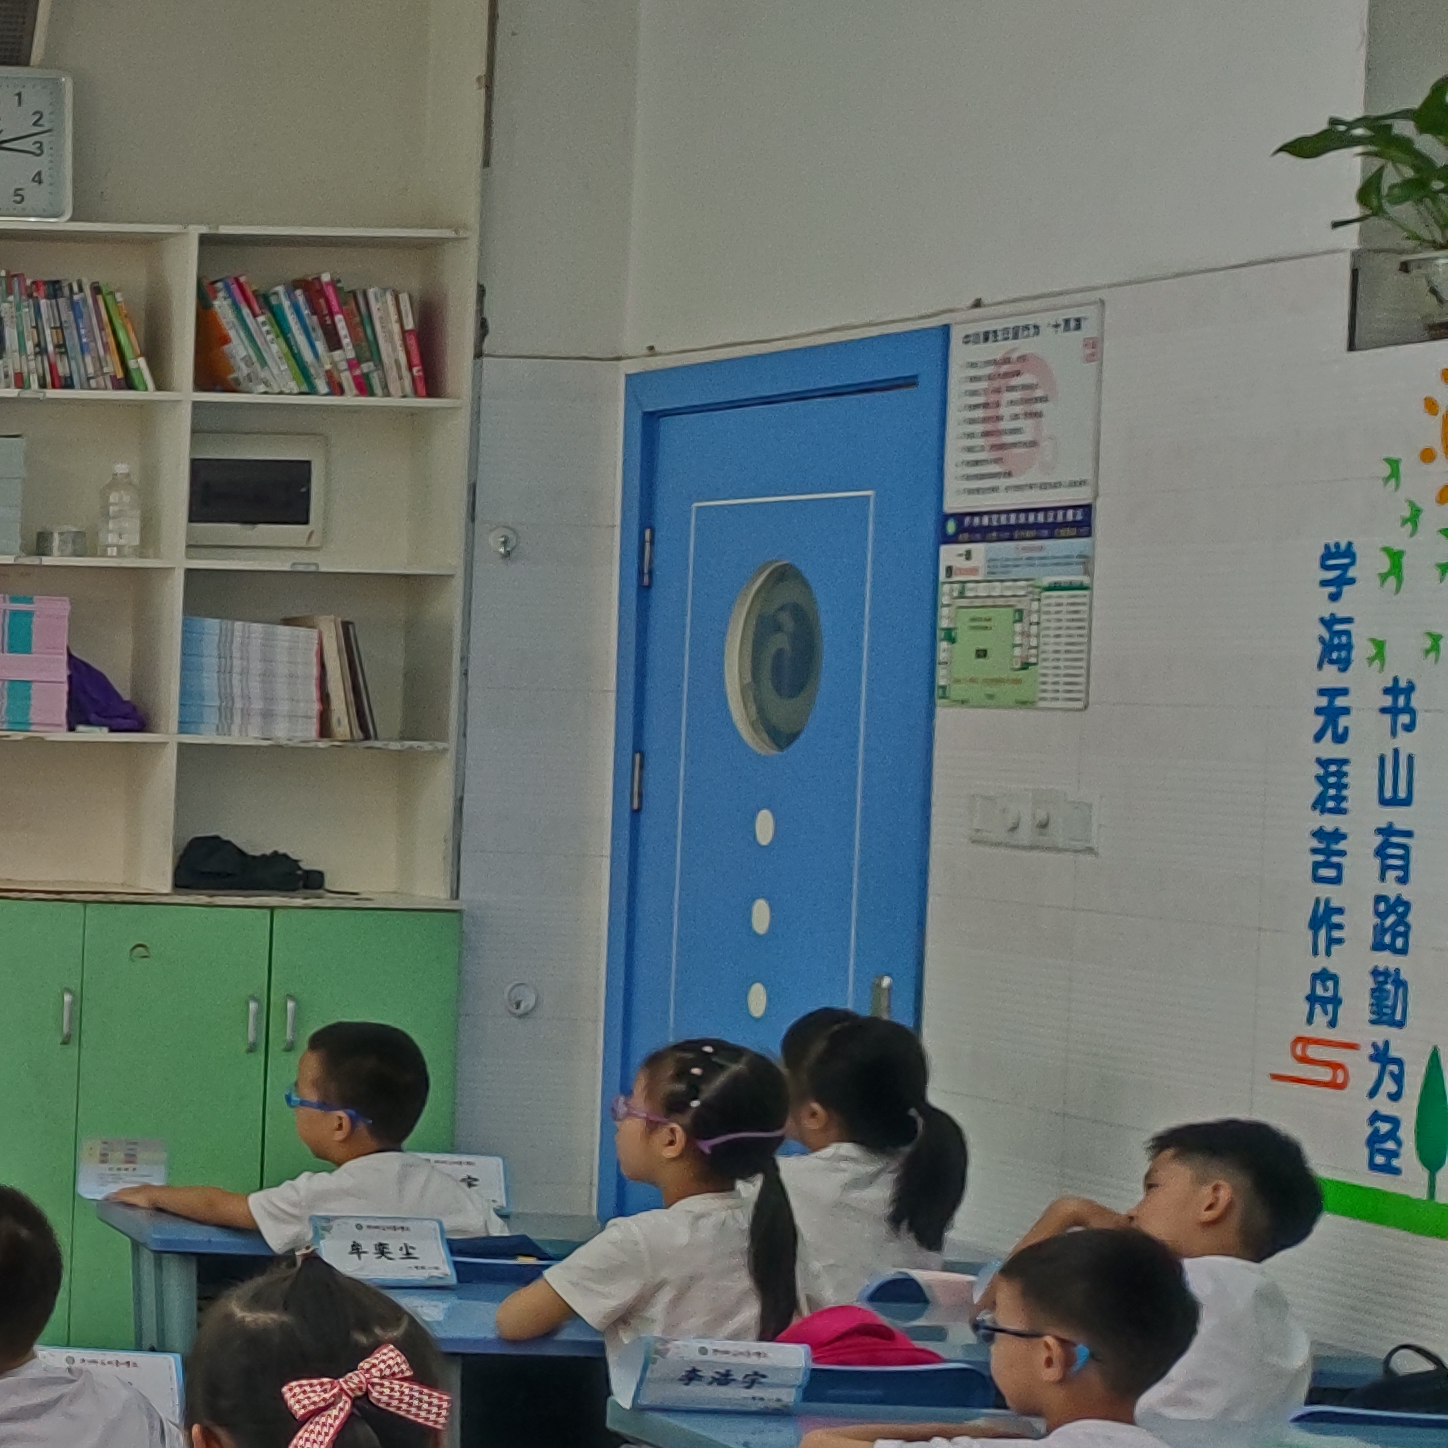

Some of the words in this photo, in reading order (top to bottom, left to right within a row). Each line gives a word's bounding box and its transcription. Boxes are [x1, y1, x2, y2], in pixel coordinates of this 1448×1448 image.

[15, 91, 22, 107] 1
[31, 111, 44, 127] 2
[31, 171, 43, 185] 4
[13, 188, 25, 204] 5
[1305, 541, 1357, 1029] 学海无涯苦作舟
[1365, 675, 1417, 1176] 书山有路勤为径
